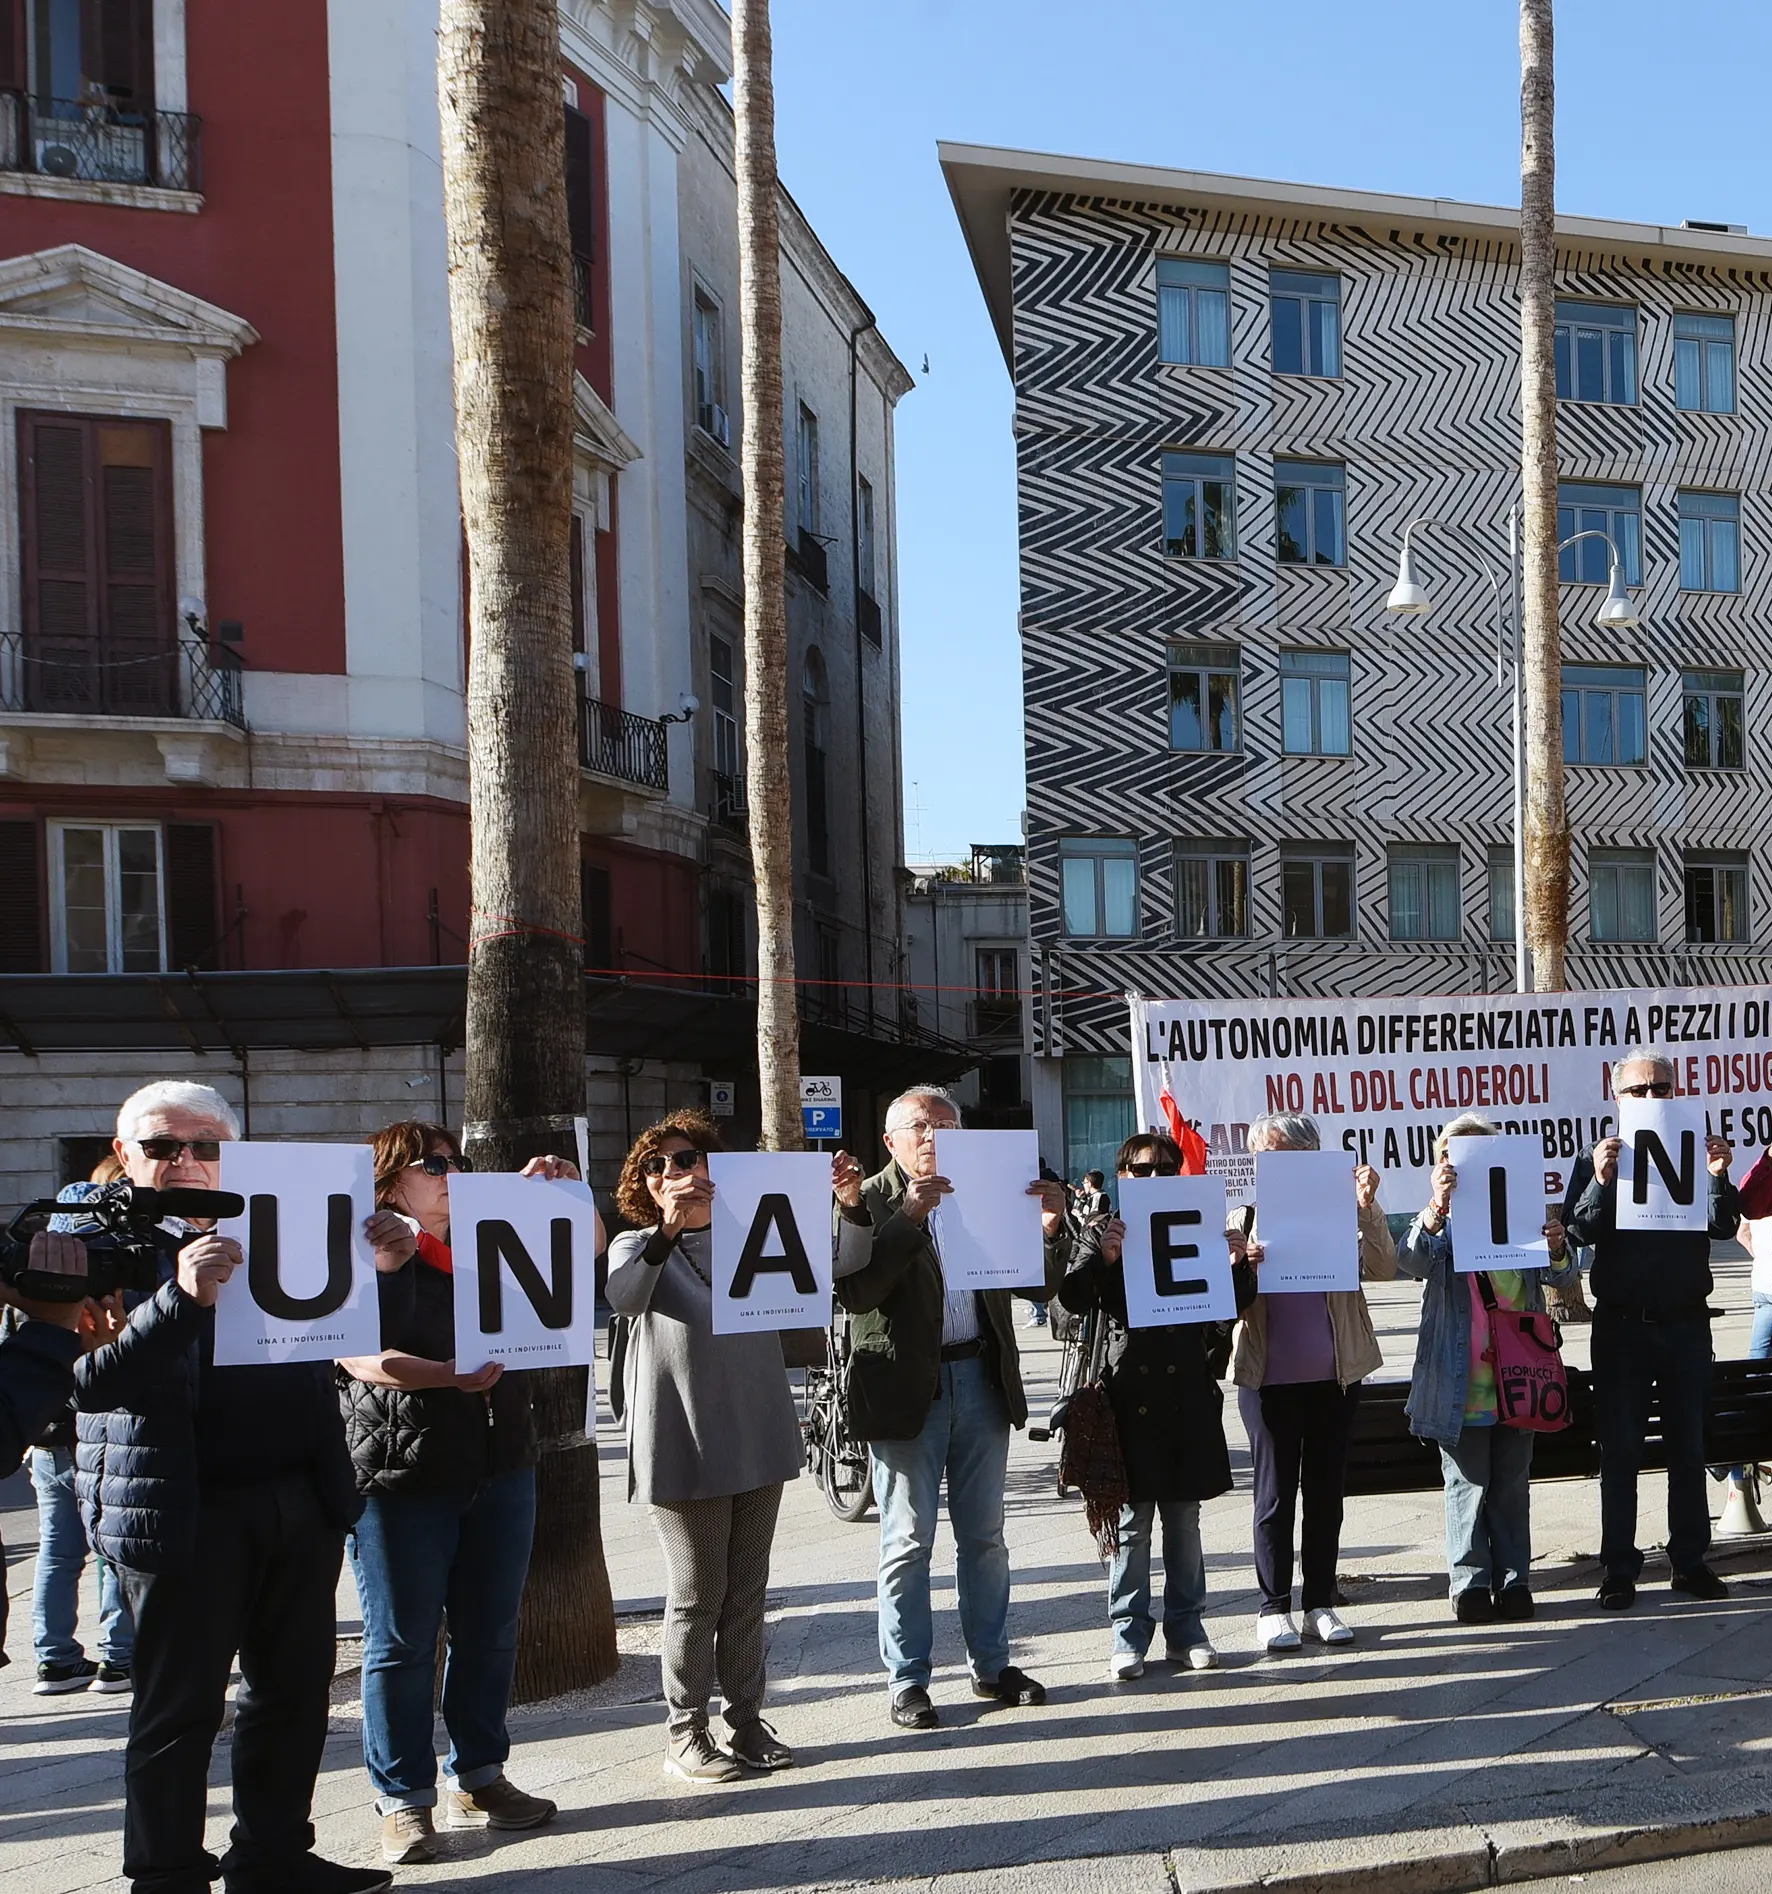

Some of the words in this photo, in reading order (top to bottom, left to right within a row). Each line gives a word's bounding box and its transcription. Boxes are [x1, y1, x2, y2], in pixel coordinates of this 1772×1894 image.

[1147, 1016, 1349, 1062] L'AUTONOMIA
[1357, 1009, 1577, 1055] DIFFERENZIATA
[1584, 1007, 1617, 1046] FA
[1624, 1006, 1642, 1045] A
[1648, 1003, 1721, 1043] PEZZI
[1728, 1003, 1736, 1039] I
[1265, 1073, 1304, 1115] NO
[1312, 1072, 1345, 1114] AL
[1350, 1069, 1404, 1113] DDL
[1409, 1063, 1550, 1110] CALDEROLI
[812, 1110, 826, 1126] P
[1205, 1159, 1227, 1168] RITIRO
[1228, 1158, 1236, 1167] DI
[1237, 1157, 1254, 1167] OGNI
[1383, 1127, 1402, 1169] A
[1633, 1129, 1695, 1206] N
[1225, 1188, 1244, 1198] RITTI
[1488, 1166, 1509, 1245] I
[248, 1193, 353, 1321] U
[728, 1193, 819, 1299] A
[1150, 1209, 1209, 1297] E
[476, 1217, 573, 1335] N
[762, 1307, 805, 1315] INDIVISIBILE
[1172, 1303, 1211, 1311] INDIVISIBILE
[290, 1333, 345, 1343] INDIVISIBILE
[514, 1343, 562, 1353] INDIVISIBILE
[1500, 1365, 1553, 1379] FIORUCCI
[1503, 1378, 1567, 1422] FIO
